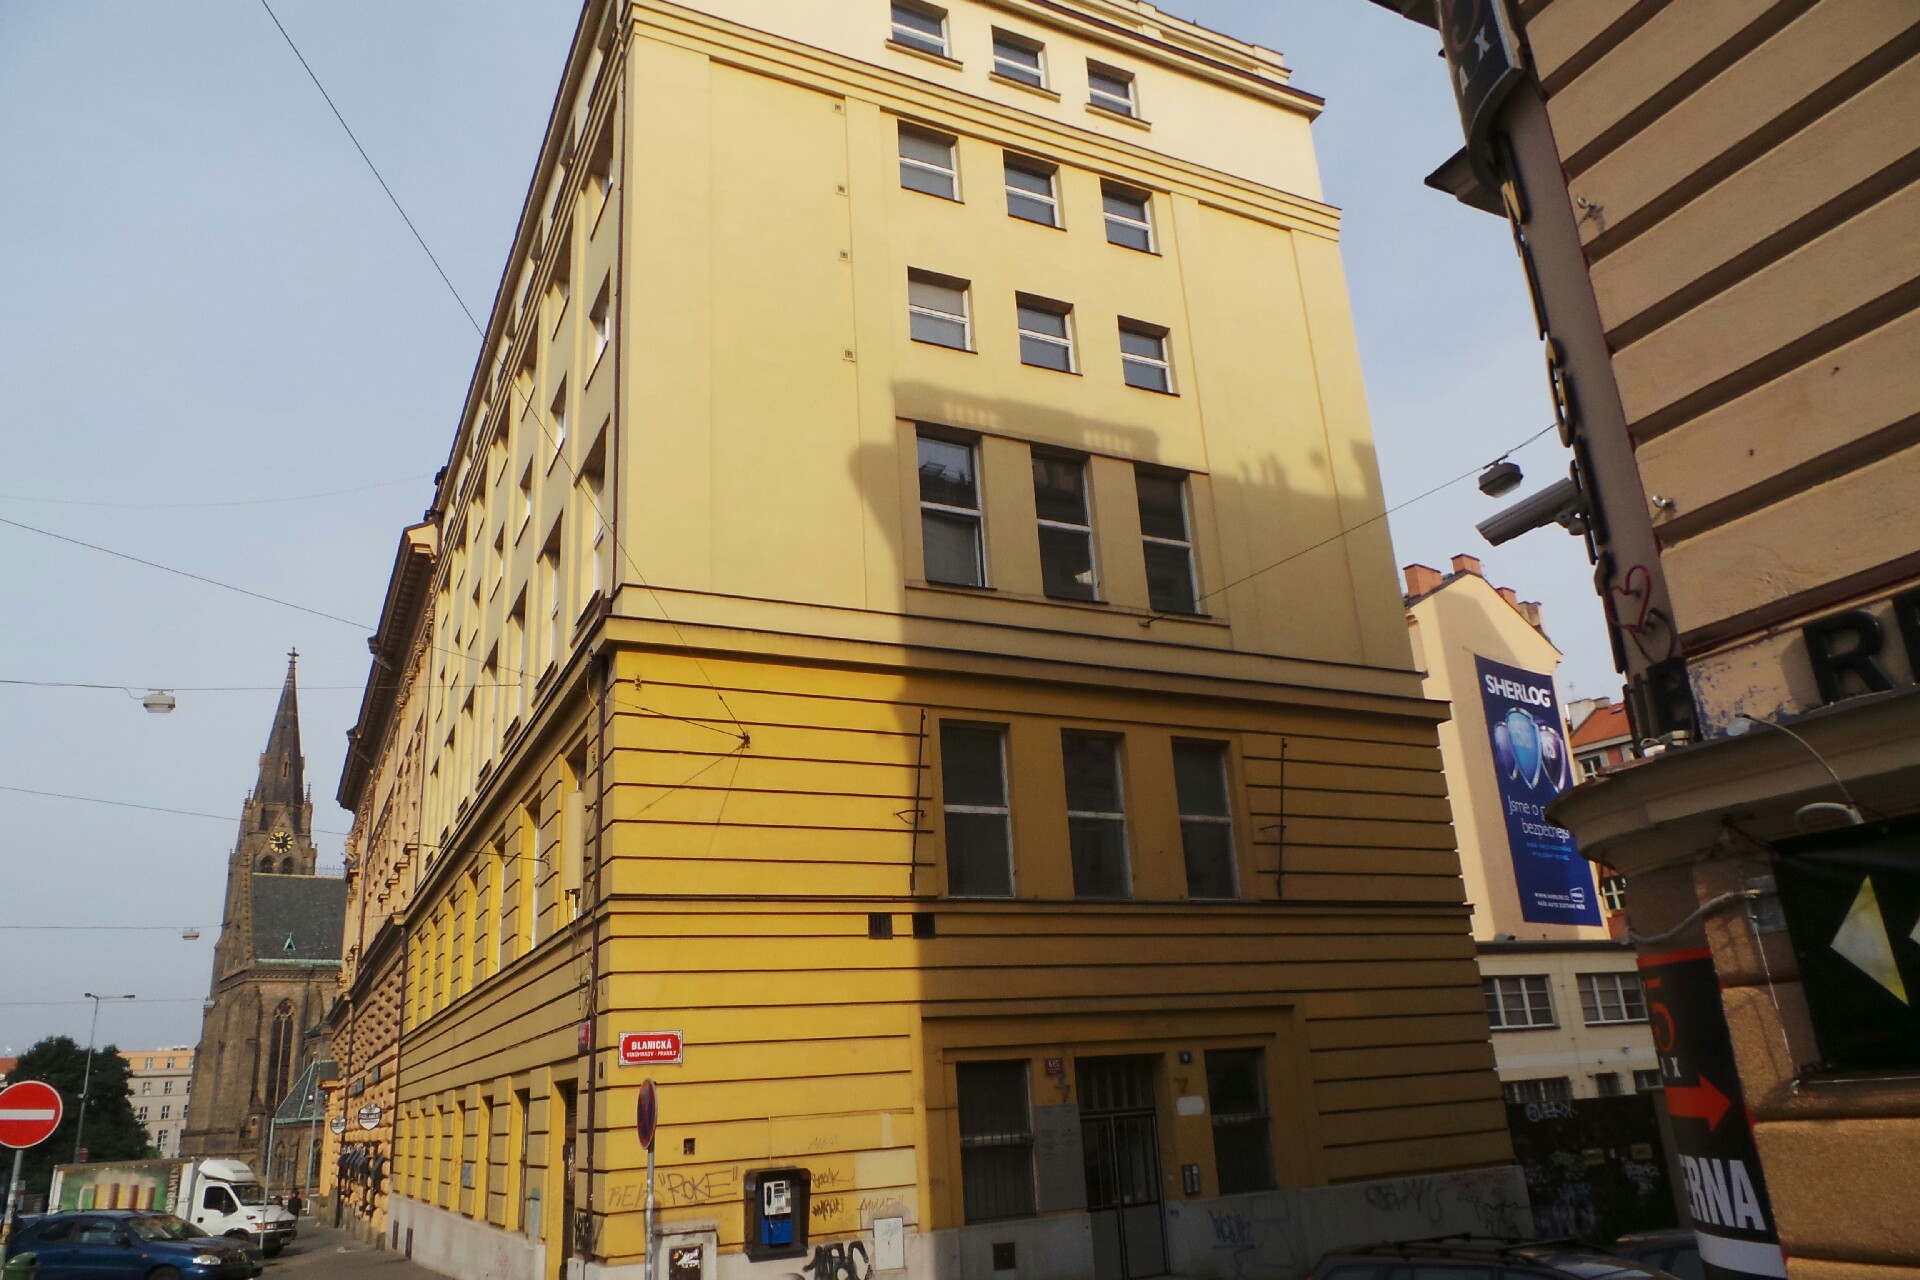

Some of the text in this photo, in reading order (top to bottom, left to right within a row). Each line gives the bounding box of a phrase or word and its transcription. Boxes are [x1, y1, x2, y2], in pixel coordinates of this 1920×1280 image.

[1485, 674, 1551, 708] SHERLOG
[1507, 794, 1530, 815] Jsme
[1532, 804, 1539, 816] o
[631, 1038, 673, 1051] BLANICKÁ
